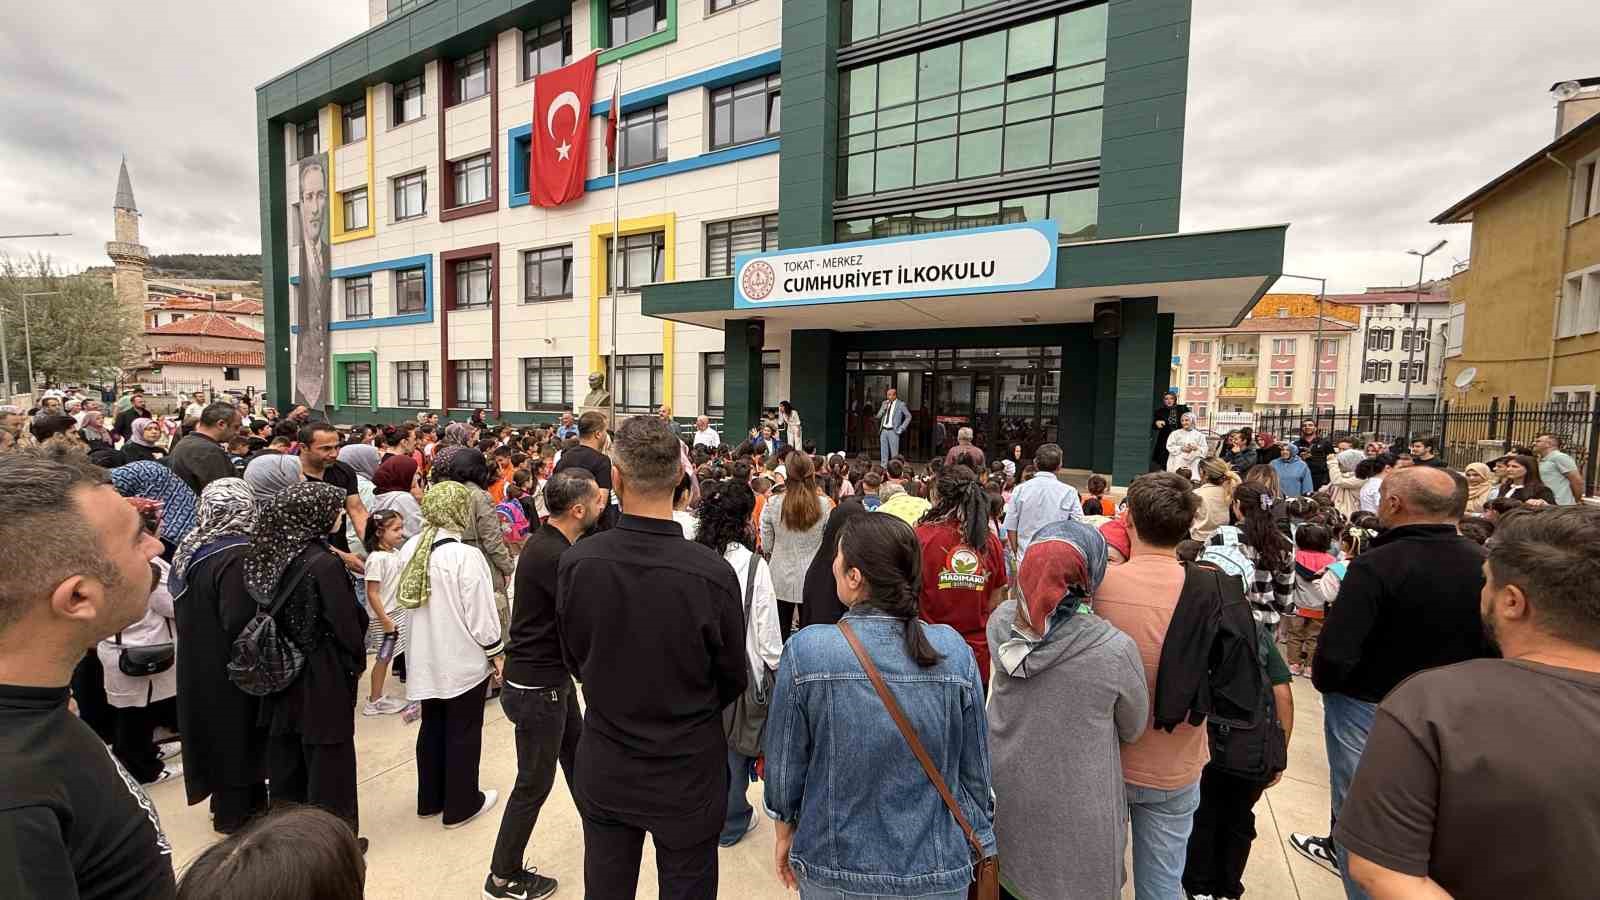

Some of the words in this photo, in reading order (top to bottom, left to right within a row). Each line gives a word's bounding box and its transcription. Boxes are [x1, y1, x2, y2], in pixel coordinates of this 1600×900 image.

[784, 260, 815, 272] TOKAT
[822, 255, 863, 267] MERKEZ
[784, 270, 893, 293] CUMHURİYET
[898, 261, 995, 284] İLKOKULU
